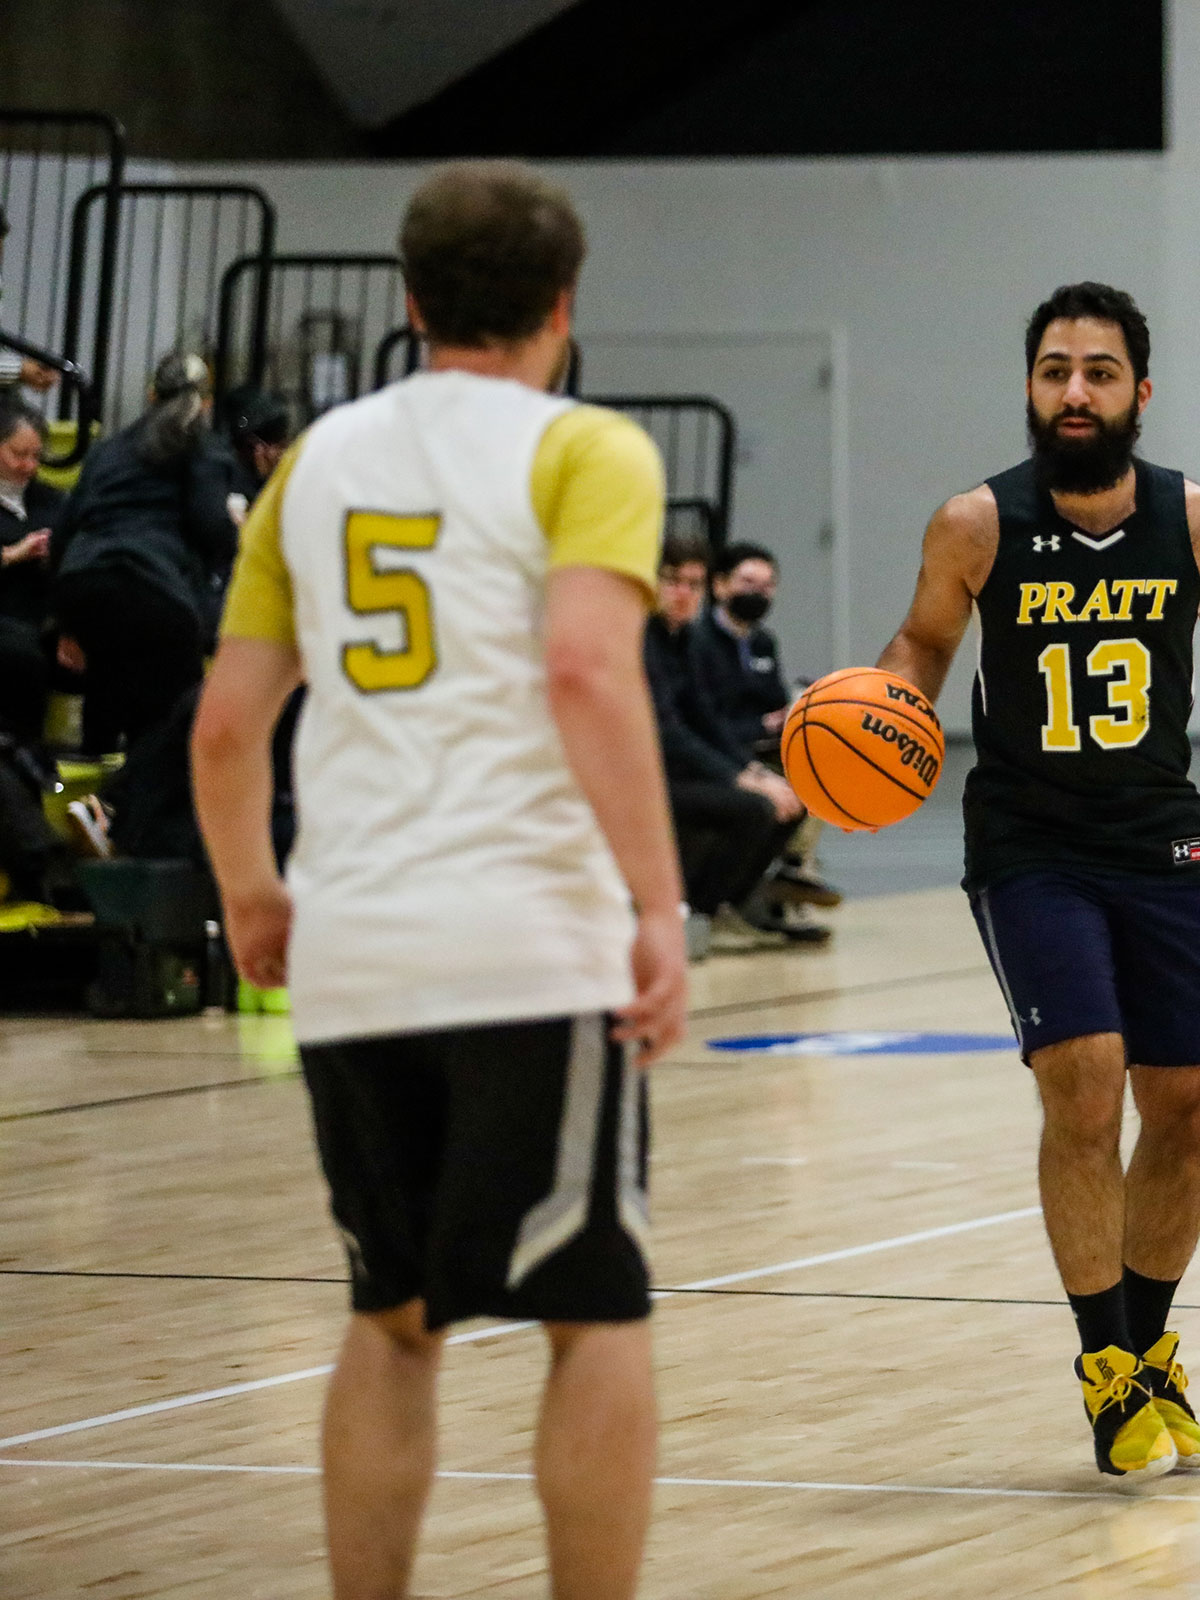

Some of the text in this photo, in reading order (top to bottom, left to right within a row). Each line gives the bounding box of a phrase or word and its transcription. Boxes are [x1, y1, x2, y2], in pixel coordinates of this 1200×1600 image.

[342, 507, 442, 696] 5
[1016, 579, 1178, 624] PRATT
[1037, 637, 1151, 752] 13
[861, 711, 939, 788] Wilson
